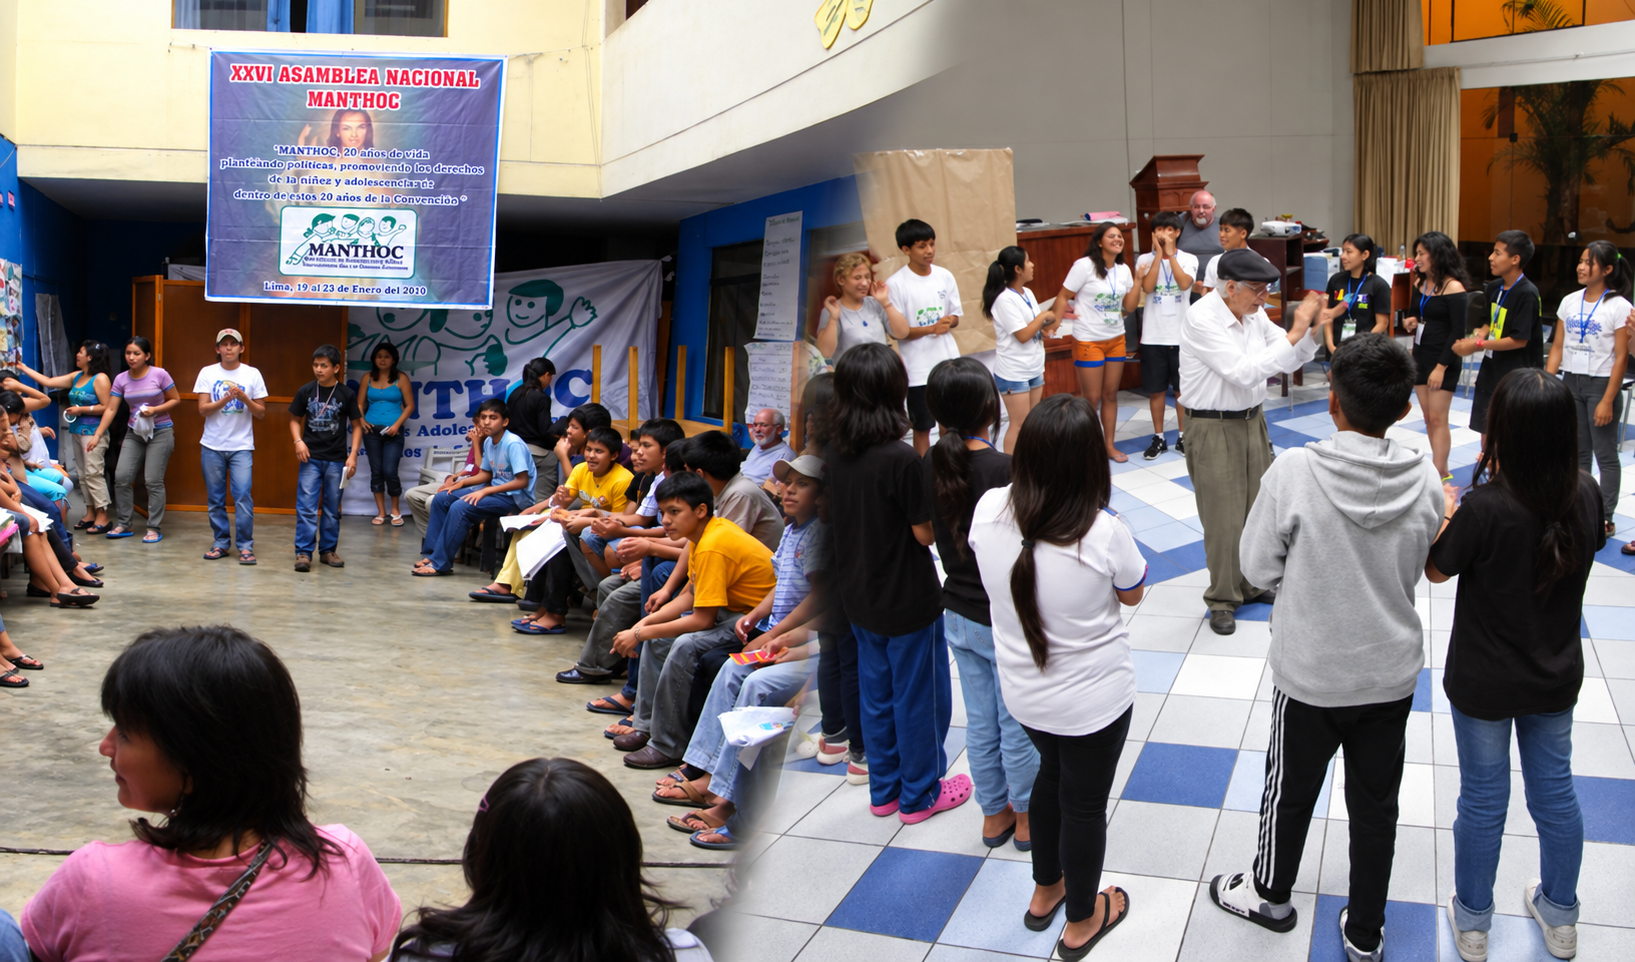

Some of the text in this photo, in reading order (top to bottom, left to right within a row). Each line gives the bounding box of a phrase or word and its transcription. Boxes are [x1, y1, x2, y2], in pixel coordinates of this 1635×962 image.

[231, 65, 479, 87] XXVI ASAMBLEA NACIONAL
[307, 91, 400, 109] MANTHOC
[344, 148, 357, 156] 20
[360, 148, 386, 158] años
[389, 149, 403, 158] de
[405, 149, 429, 159] vida
[415, 164, 431, 173] los
[434, 164, 484, 174] derechos
[269, 175, 282, 184] de
[286, 176, 296, 184] la
[300, 176, 331, 185] niñez
[335, 178, 341, 186] y
[234, 190, 270, 199] dentro
[273, 191, 286, 200] de
[289, 193, 317, 201] estos
[320, 193, 333, 201] 20
[336, 193, 361, 202] años
[364, 194, 377, 203] de
[381, 195, 390, 203] la
[309, 243, 404, 259] MANTHOC
[265, 282, 427, 295] Lima, 19 al 23 de Enero del 2010
